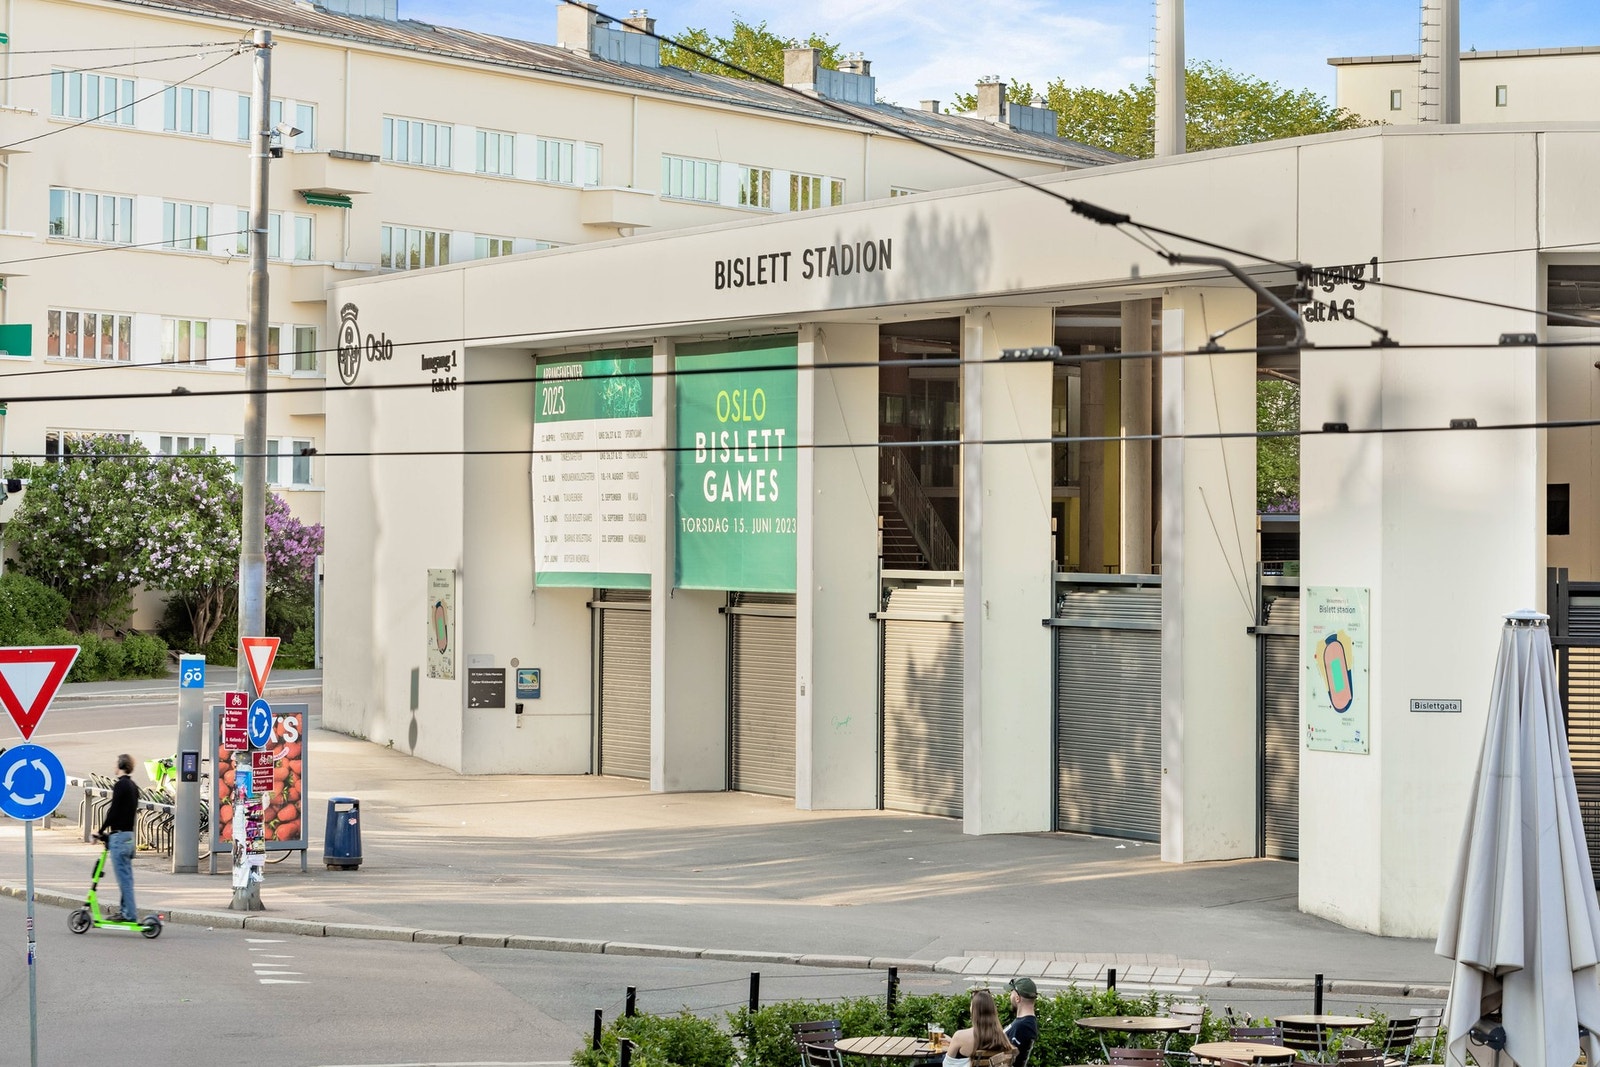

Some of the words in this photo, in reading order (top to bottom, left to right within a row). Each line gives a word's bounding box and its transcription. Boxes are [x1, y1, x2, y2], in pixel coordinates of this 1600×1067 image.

[715, 251, 792, 290] BISLETT
[802, 238, 892, 280] STADION
[1370, 256, 1380, 282] 1
[1328, 299, 1355, 322] A-G
[366, 332, 393, 362] Oslo
[452, 350, 458, 367] 1
[542, 386, 566, 416] 2023
[716, 388, 766, 422] OSLO
[696, 428, 786, 464] BISLETT
[703, 468, 779, 502] GAMES
[681, 517, 729, 533] TORSDAG
[734, 518, 748, 533] 15.
[752, 518, 772, 534] JUNI
[776, 518, 796, 534] 2023
[1414, 701, 1457, 711] Bislettgata
